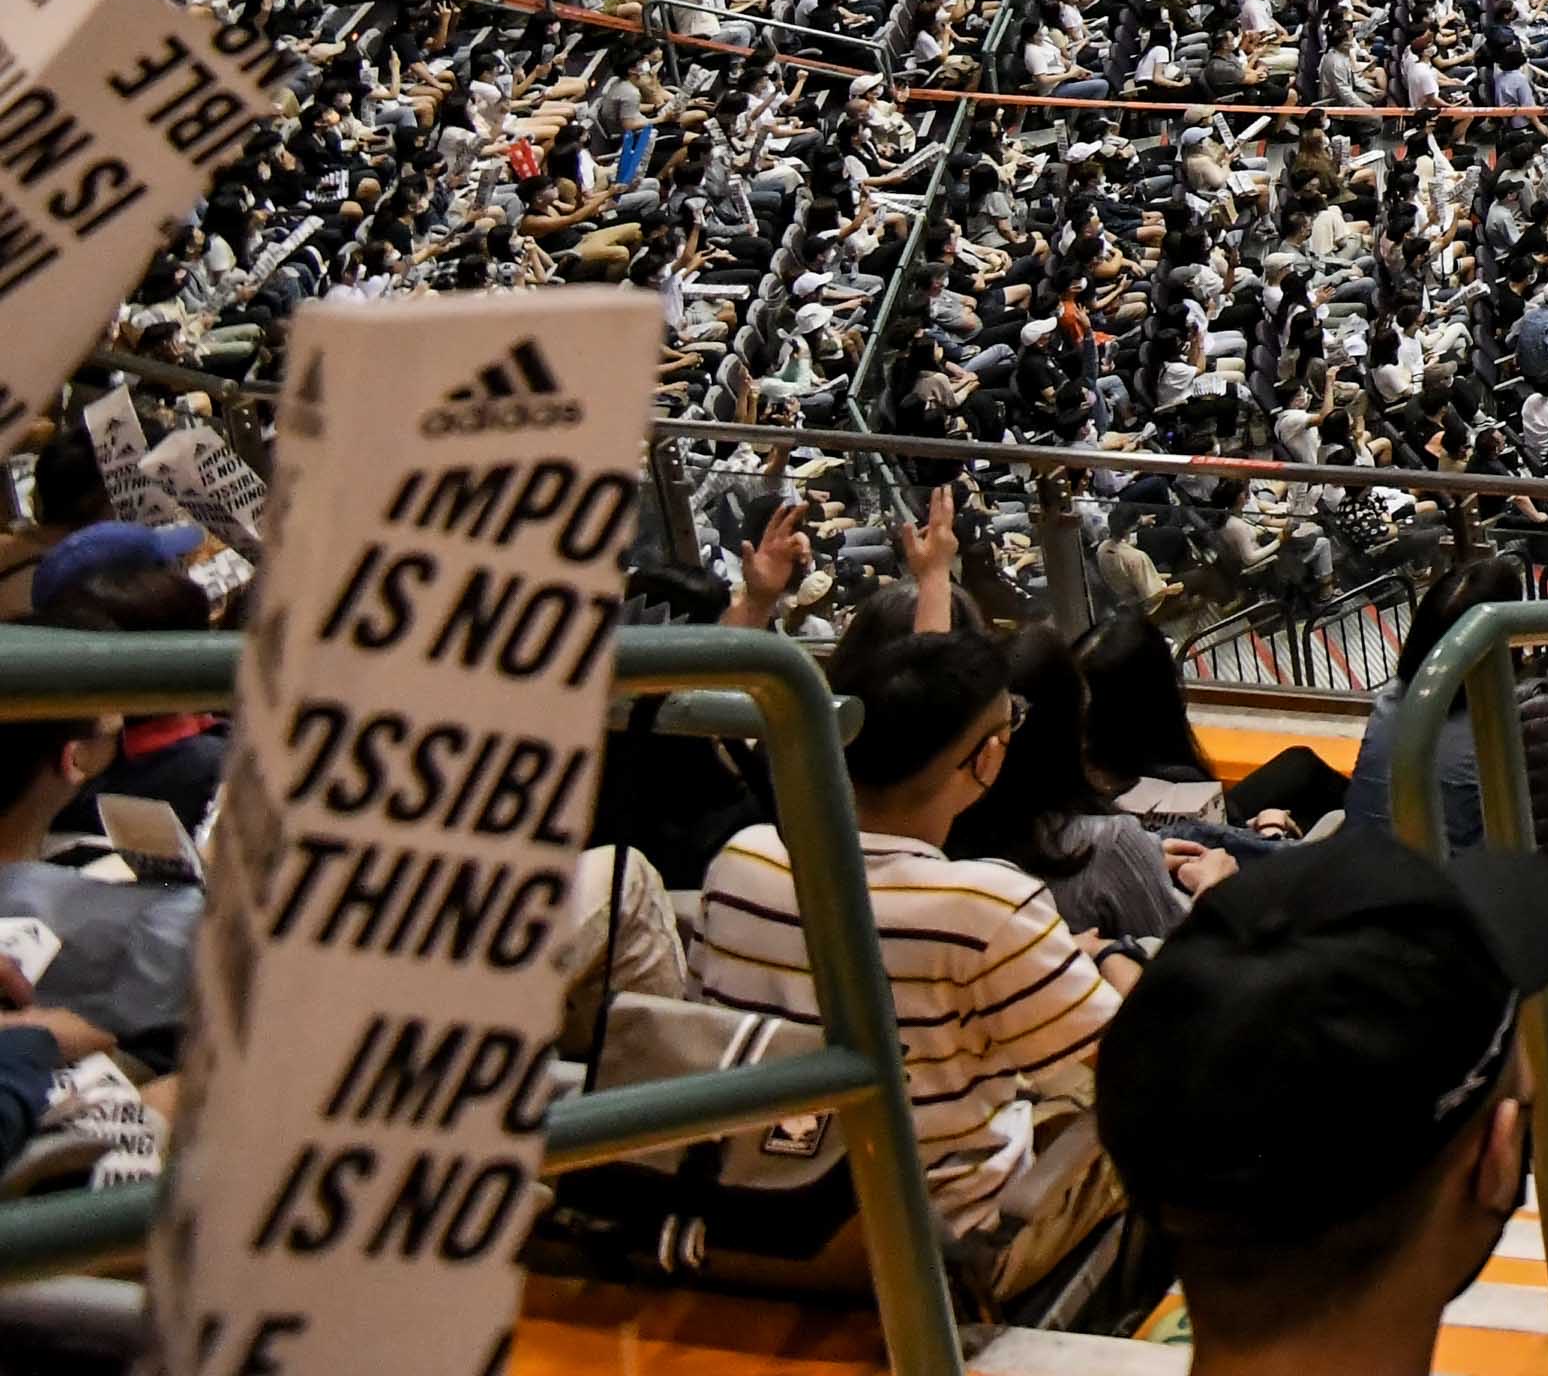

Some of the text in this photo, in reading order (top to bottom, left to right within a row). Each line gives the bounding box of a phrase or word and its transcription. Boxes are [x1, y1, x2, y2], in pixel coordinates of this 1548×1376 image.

[420, 397, 585, 440] adidas
[201, 470, 216, 487] IS
[384, 460, 639, 564] IMPO
[316, 542, 439, 655] IS
[268, 836, 571, 973] THING
[254, 1140, 378, 1255] IS
